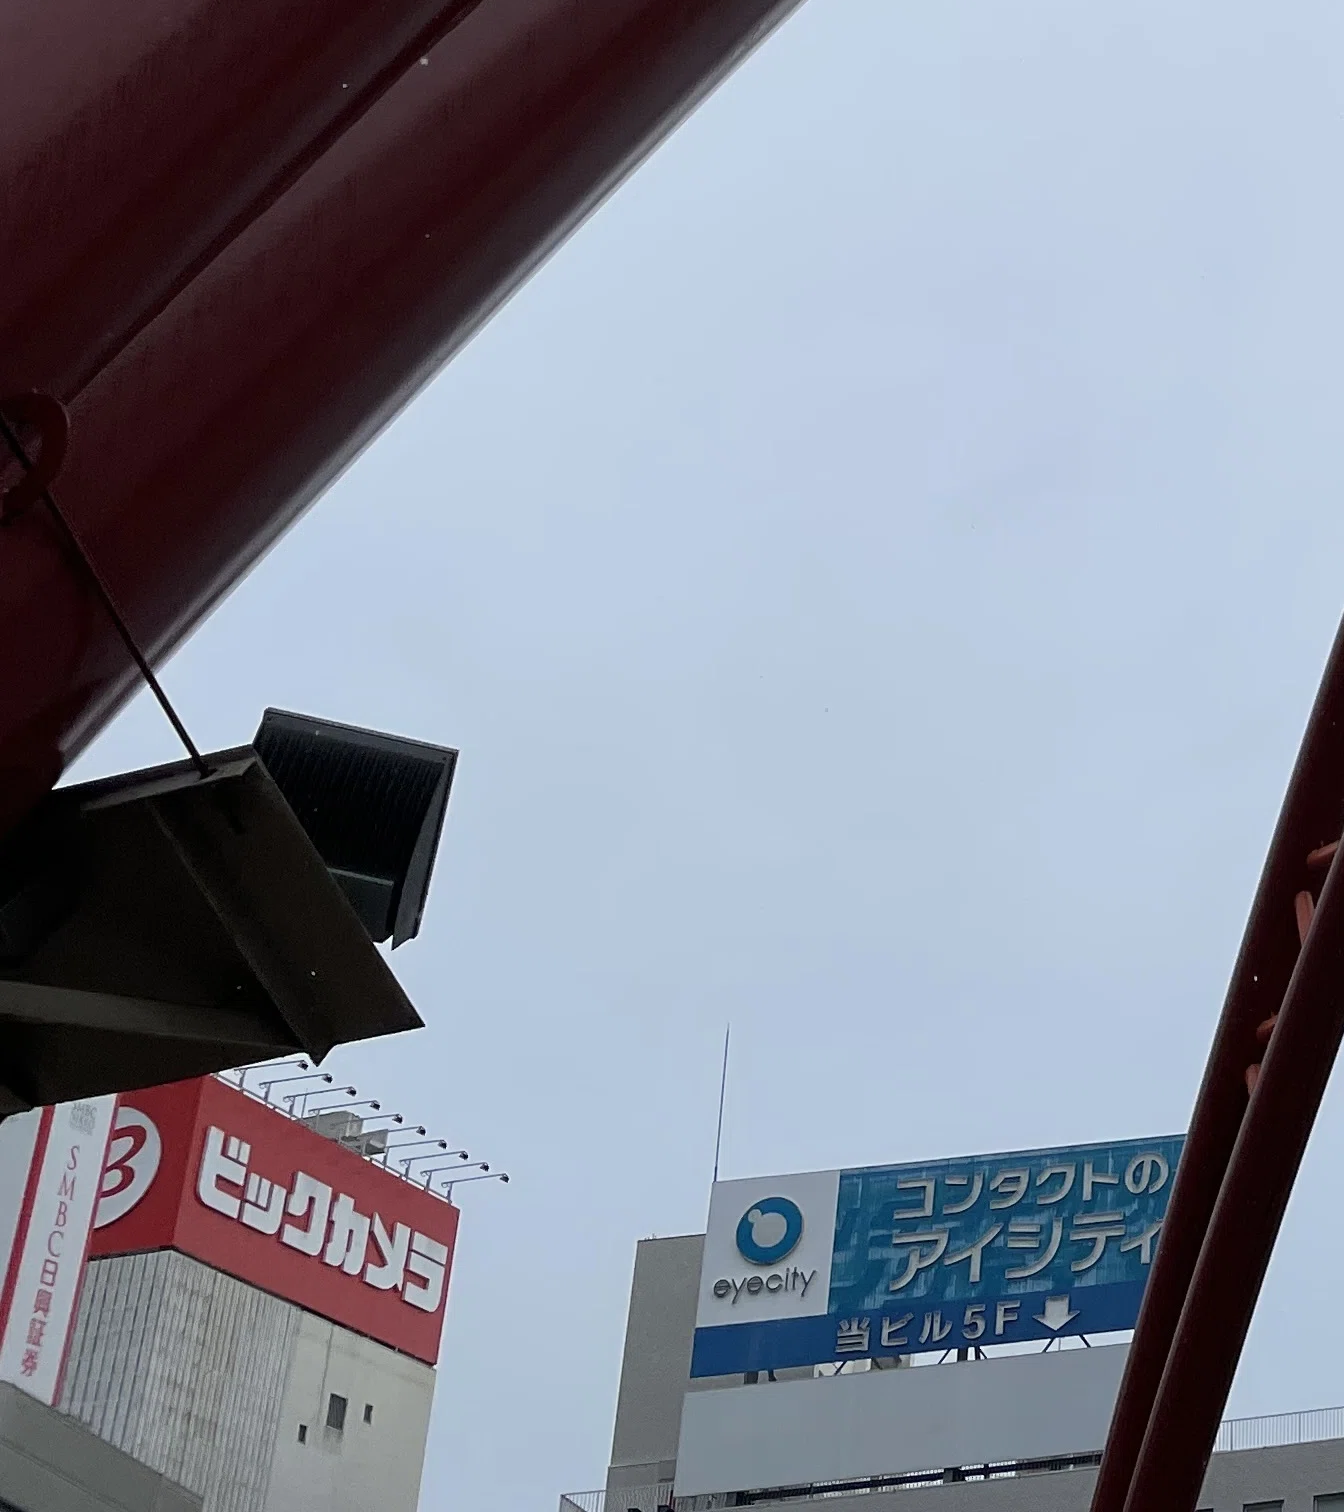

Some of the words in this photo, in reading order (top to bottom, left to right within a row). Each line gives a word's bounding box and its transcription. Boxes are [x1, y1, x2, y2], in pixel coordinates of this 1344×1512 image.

[893, 1150, 1170, 1220] コンタクトの
[196, 1125, 448, 1313] ビックカメラ
[712, 1266, 818, 1305] eyecity
[835, 1300, 1021, 1354] 当ビル5F
